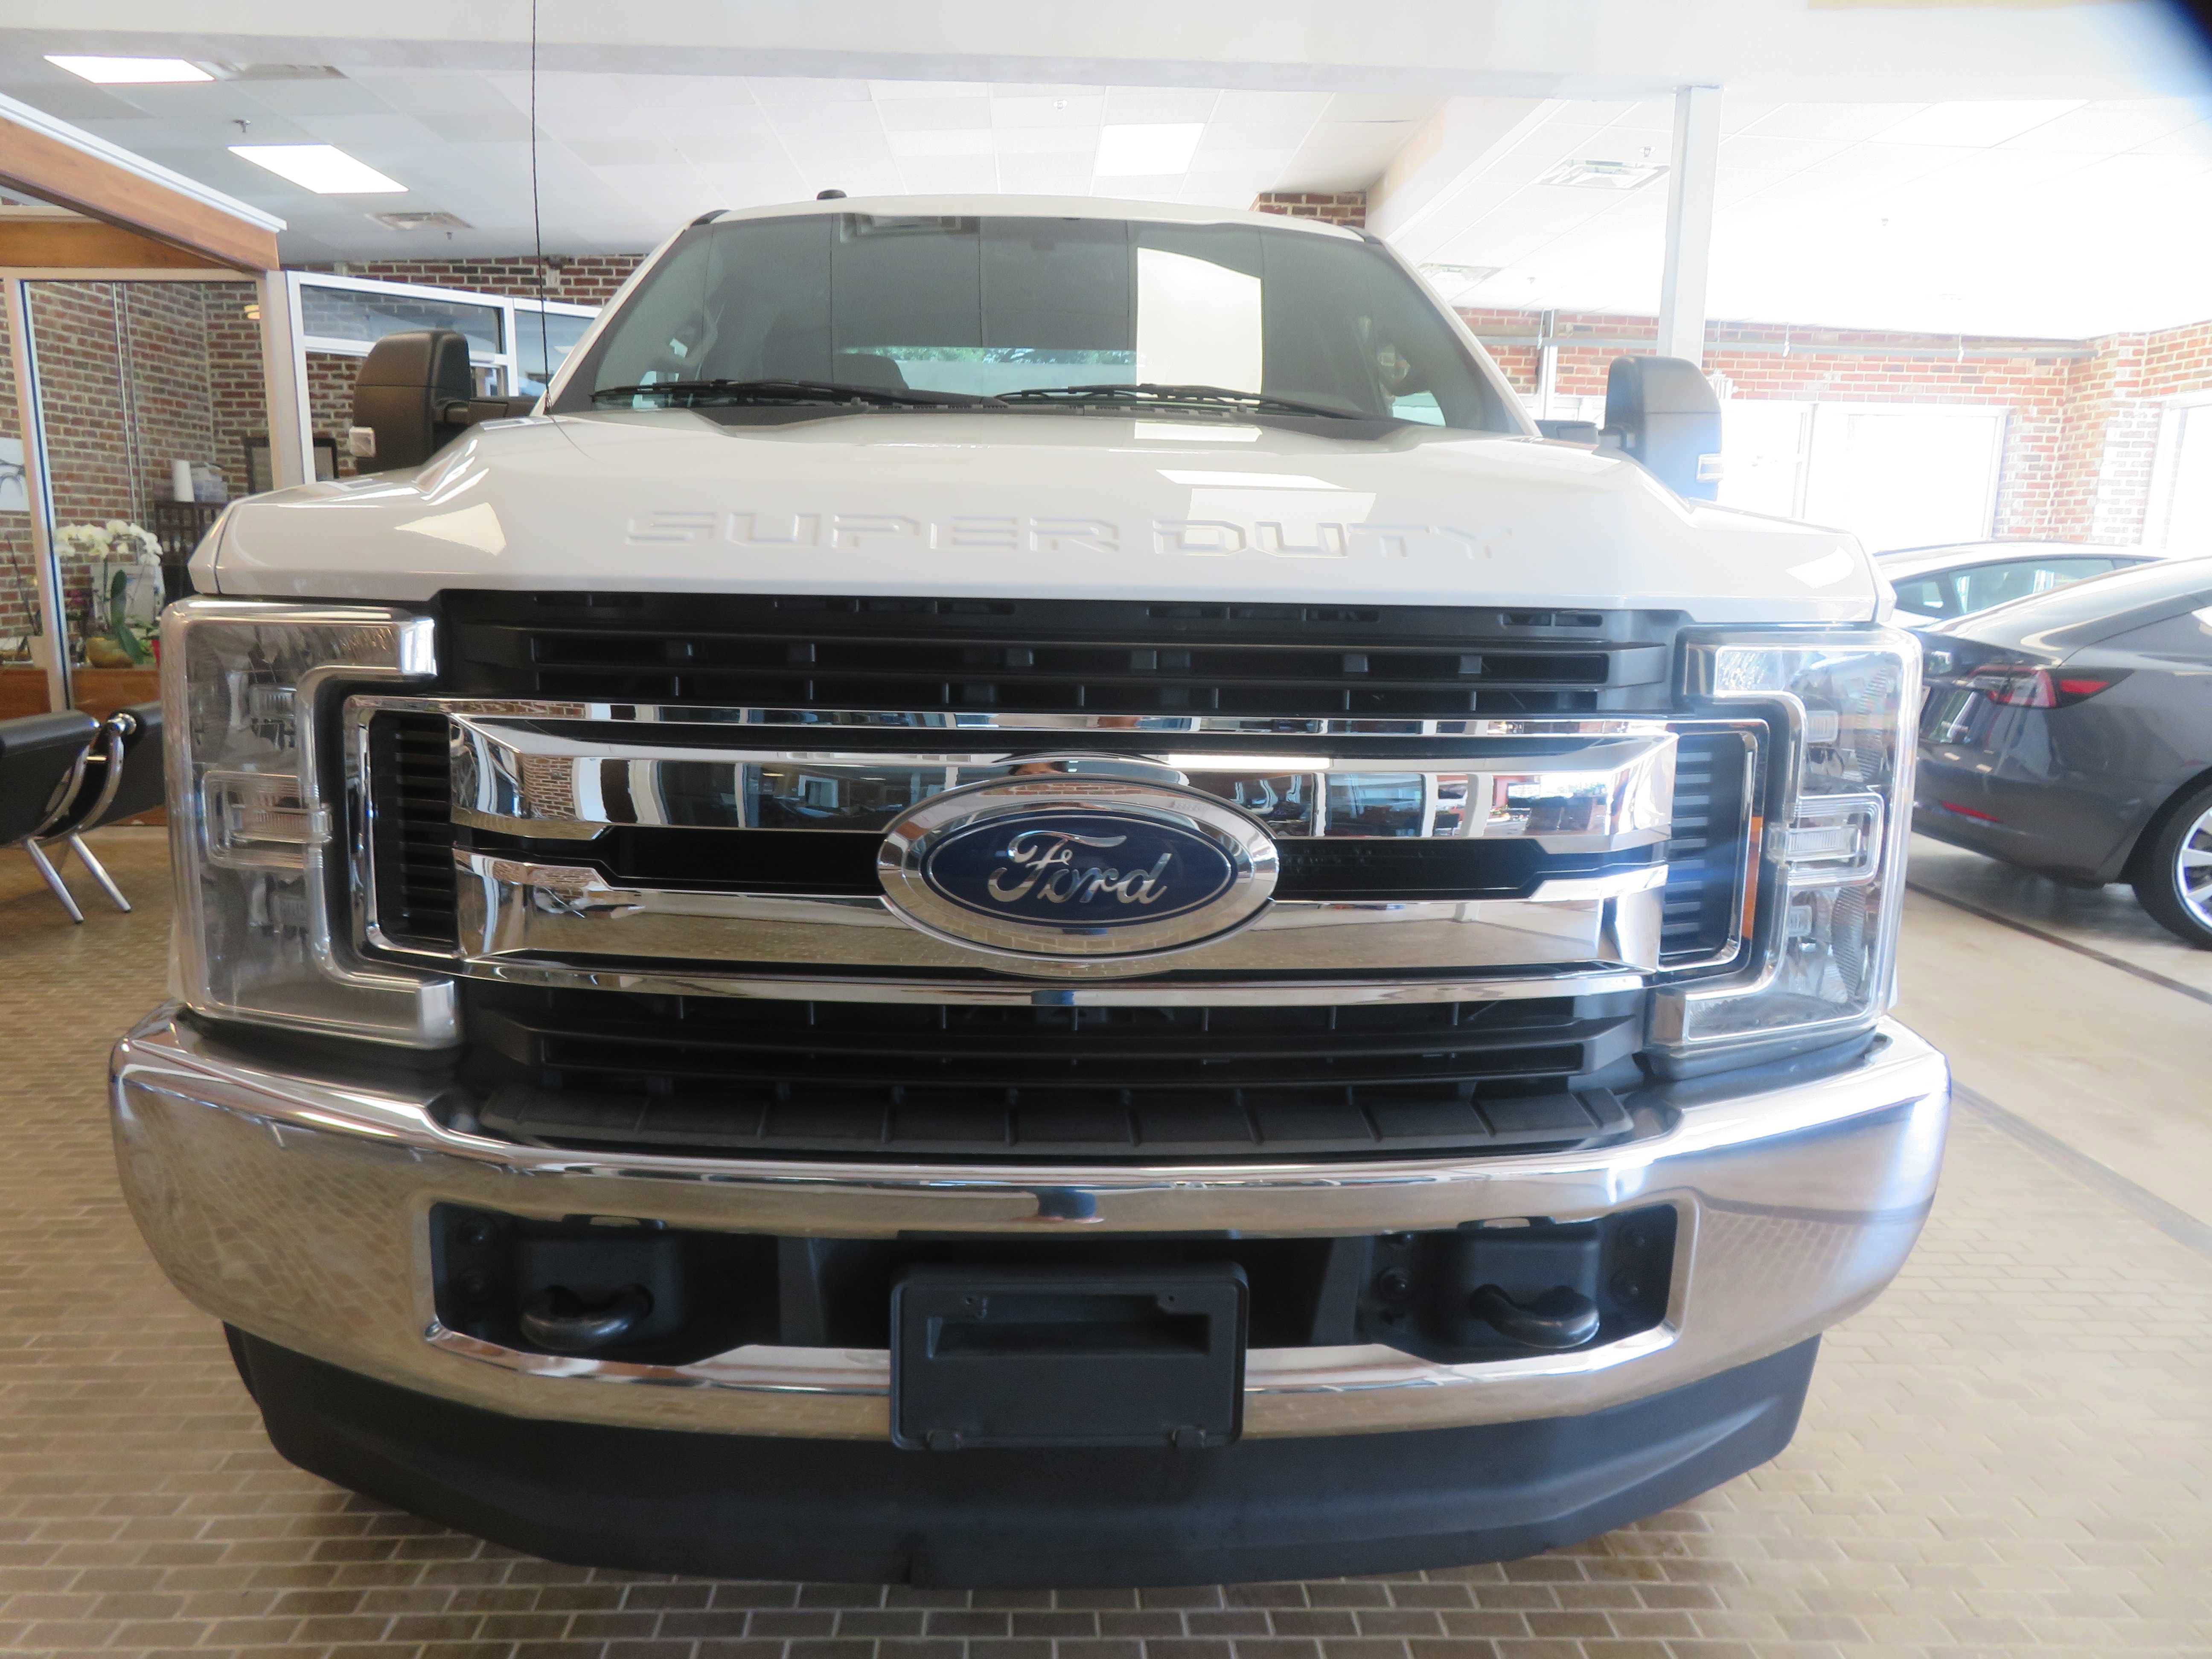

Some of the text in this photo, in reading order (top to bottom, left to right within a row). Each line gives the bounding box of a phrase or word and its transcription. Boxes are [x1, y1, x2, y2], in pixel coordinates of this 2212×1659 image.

[624, 511, 1512, 559] SUPER DUTY
[988, 830, 1172, 904] Ford
